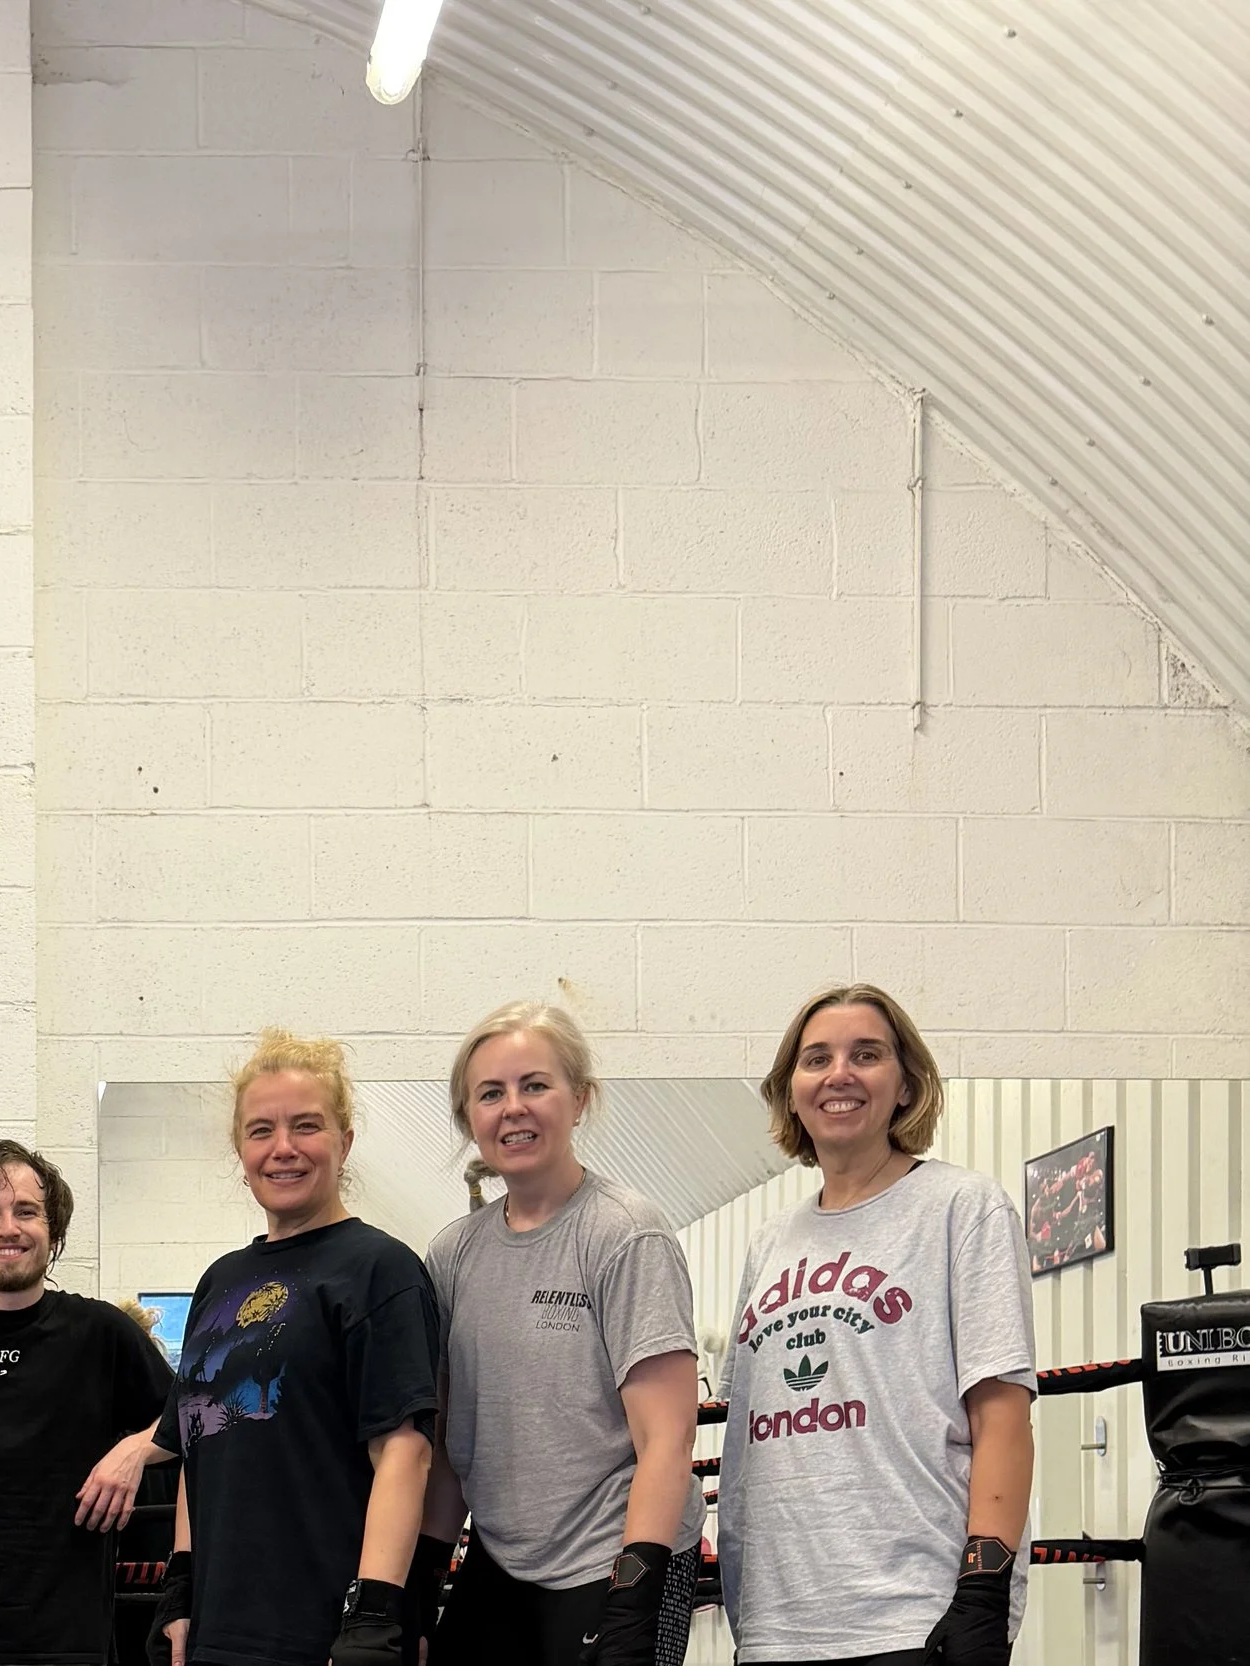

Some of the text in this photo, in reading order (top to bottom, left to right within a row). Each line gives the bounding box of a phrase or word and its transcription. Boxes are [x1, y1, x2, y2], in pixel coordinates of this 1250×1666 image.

[531, 1290, 592, 1310] RELENTLESS
[738, 1252, 913, 1344] adidas
[535, 1320, 581, 1332] LONDON
[749, 1305, 875, 1354] love your city
[786, 1328, 826, 1350] club
[750, 1398, 866, 1444] london
